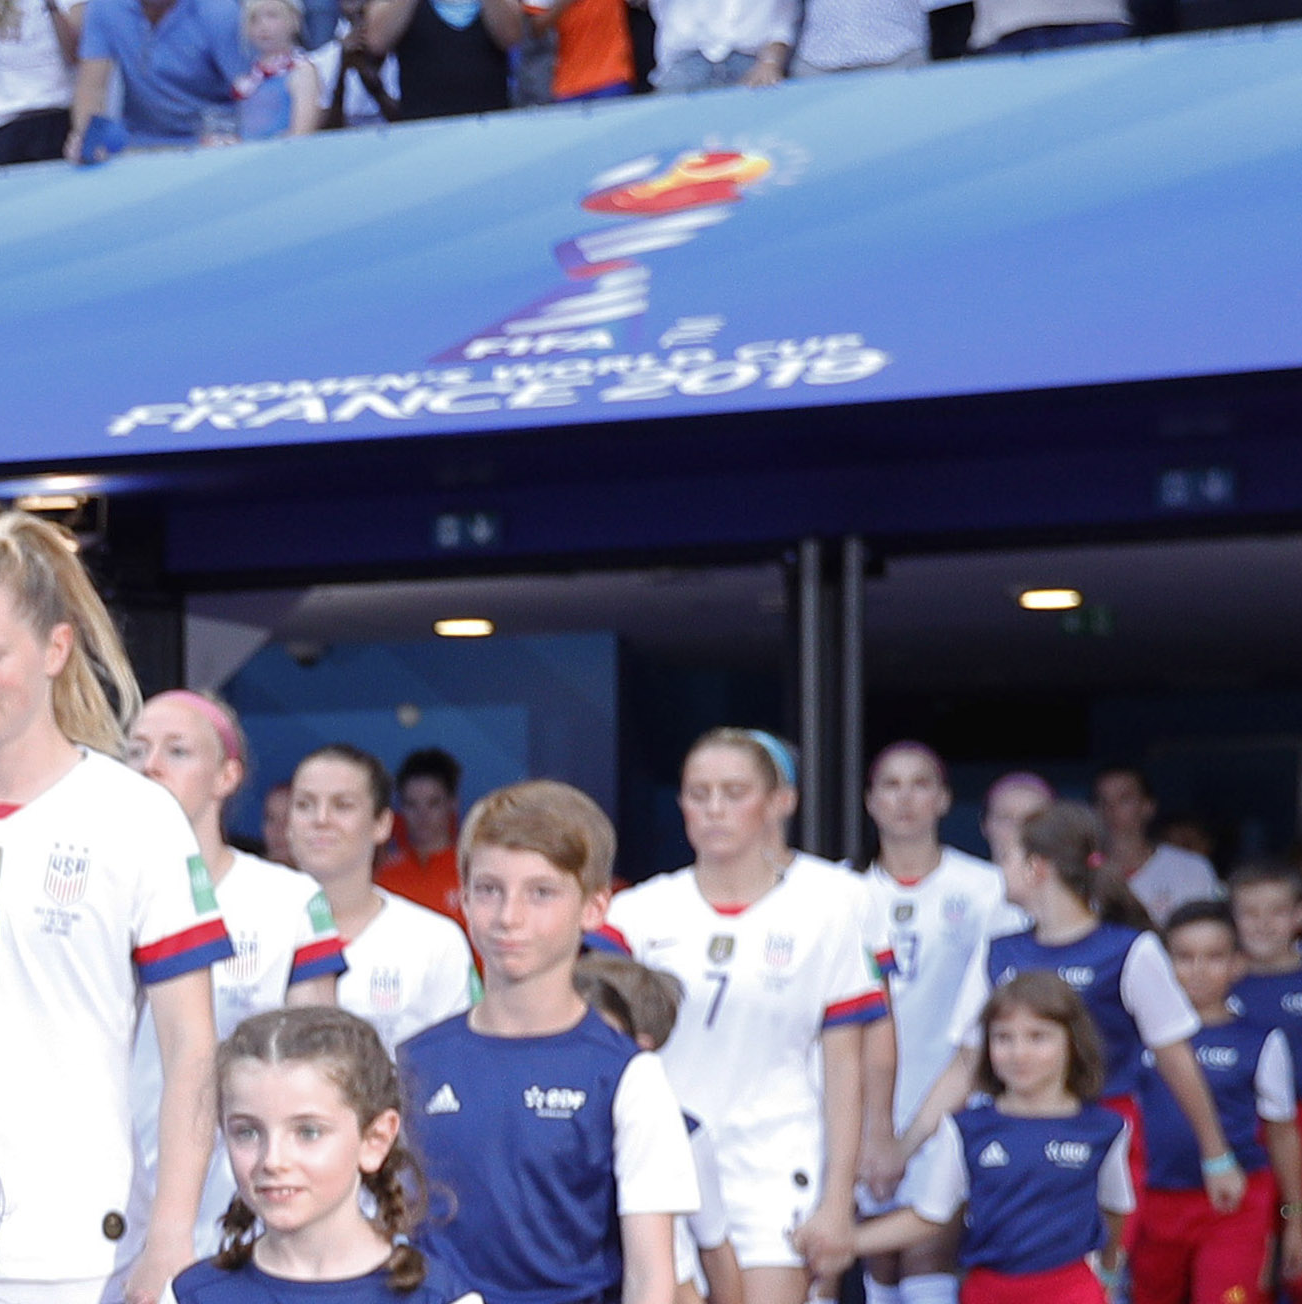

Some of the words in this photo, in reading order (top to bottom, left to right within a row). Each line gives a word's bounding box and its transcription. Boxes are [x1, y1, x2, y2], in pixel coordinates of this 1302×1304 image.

[106, 378, 594, 437] FRANCE
[601, 346, 890, 402] 2019
[704, 970, 729, 1029] 7
